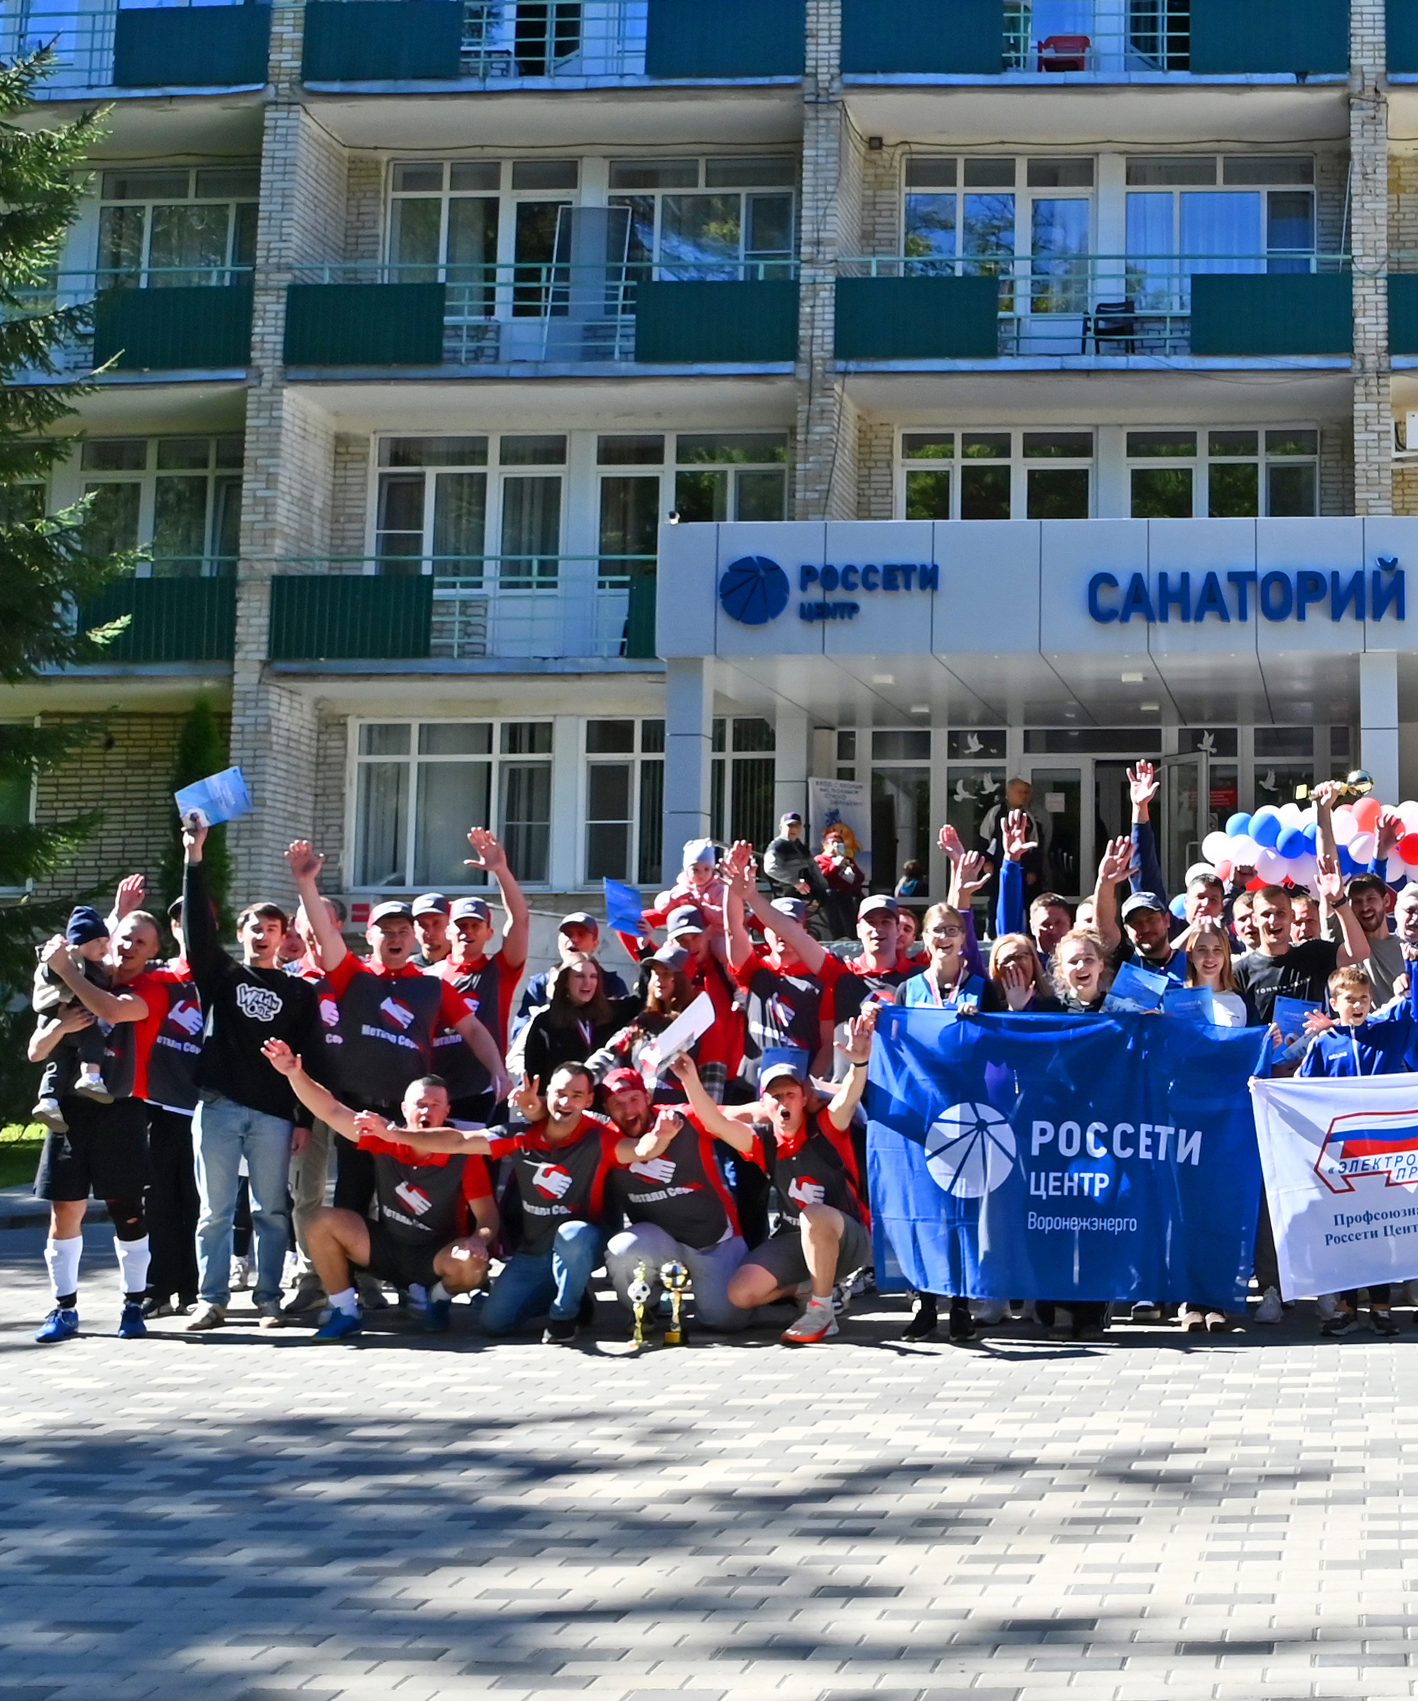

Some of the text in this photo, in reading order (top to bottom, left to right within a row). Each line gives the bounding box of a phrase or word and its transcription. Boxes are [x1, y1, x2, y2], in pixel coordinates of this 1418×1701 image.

[799, 564, 939, 592] РОССЕТИ
[1087, 556, 1405, 624] САНАТОРИЙ
[799, 602, 861, 623] ЦЕНТР
[1031, 1120, 1202, 1166] РОССЕТИ
[1029, 1171, 1110, 1200] ЦЕНТР
[1027, 1211, 1138, 1235] Воронежэнерго
[1324, 1227, 1379, 1246] Россети
